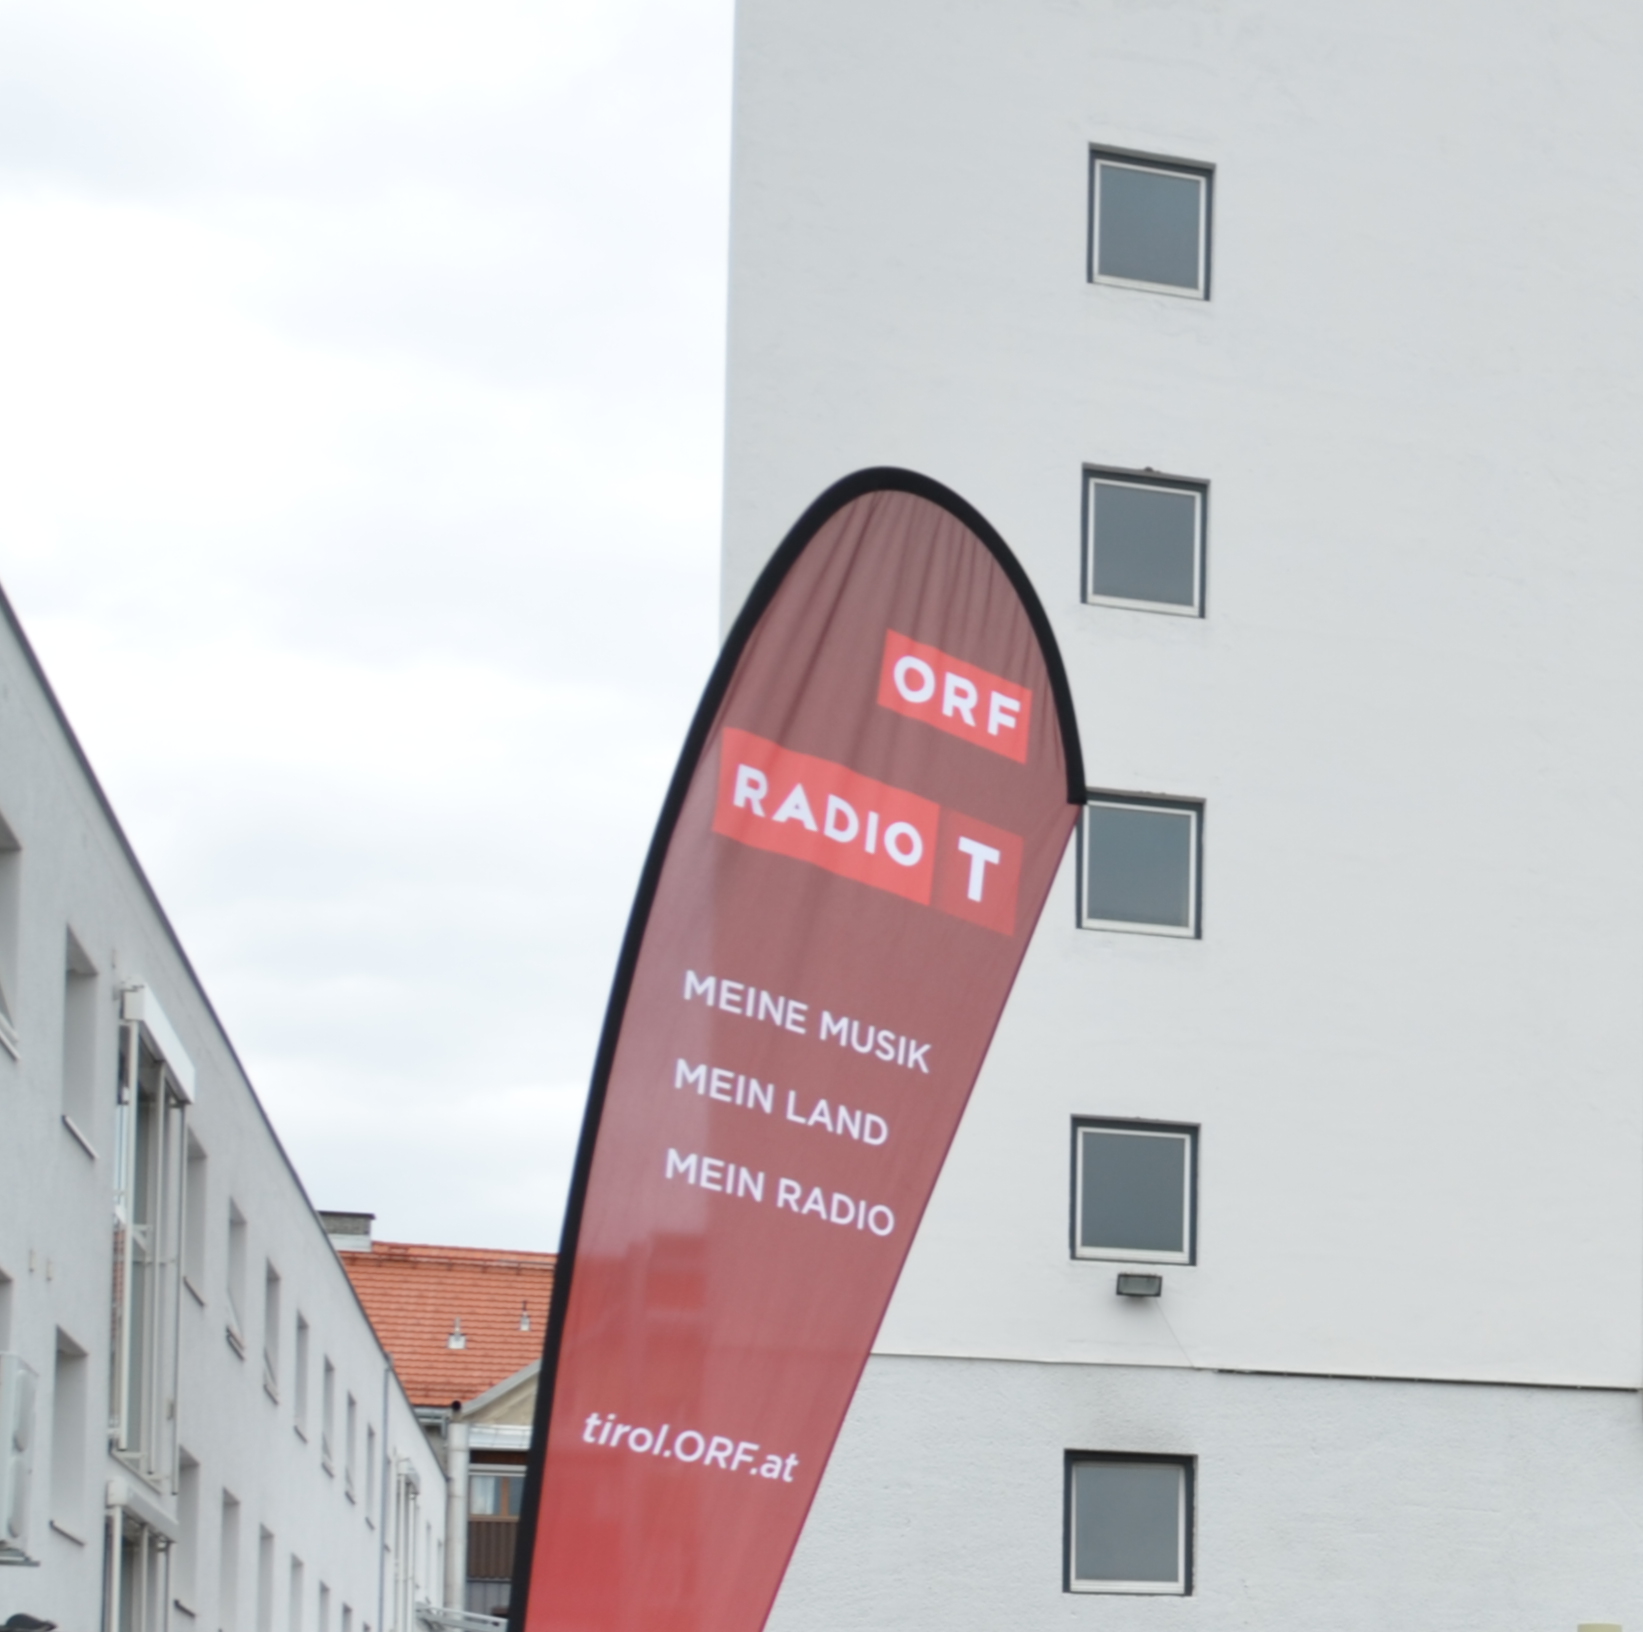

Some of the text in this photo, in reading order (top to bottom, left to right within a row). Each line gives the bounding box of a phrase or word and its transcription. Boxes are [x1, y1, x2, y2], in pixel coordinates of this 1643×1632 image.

[892, 654, 1023, 738] ORF
[732, 762, 1002, 904] RADIO T
[682, 968, 933, 1075] MEINE MUSIK
[673, 1057, 890, 1147] MEIN LAND
[664, 1146, 896, 1238] MEIN RADIO
[580, 1410, 801, 1484] tirol.ORF.at
